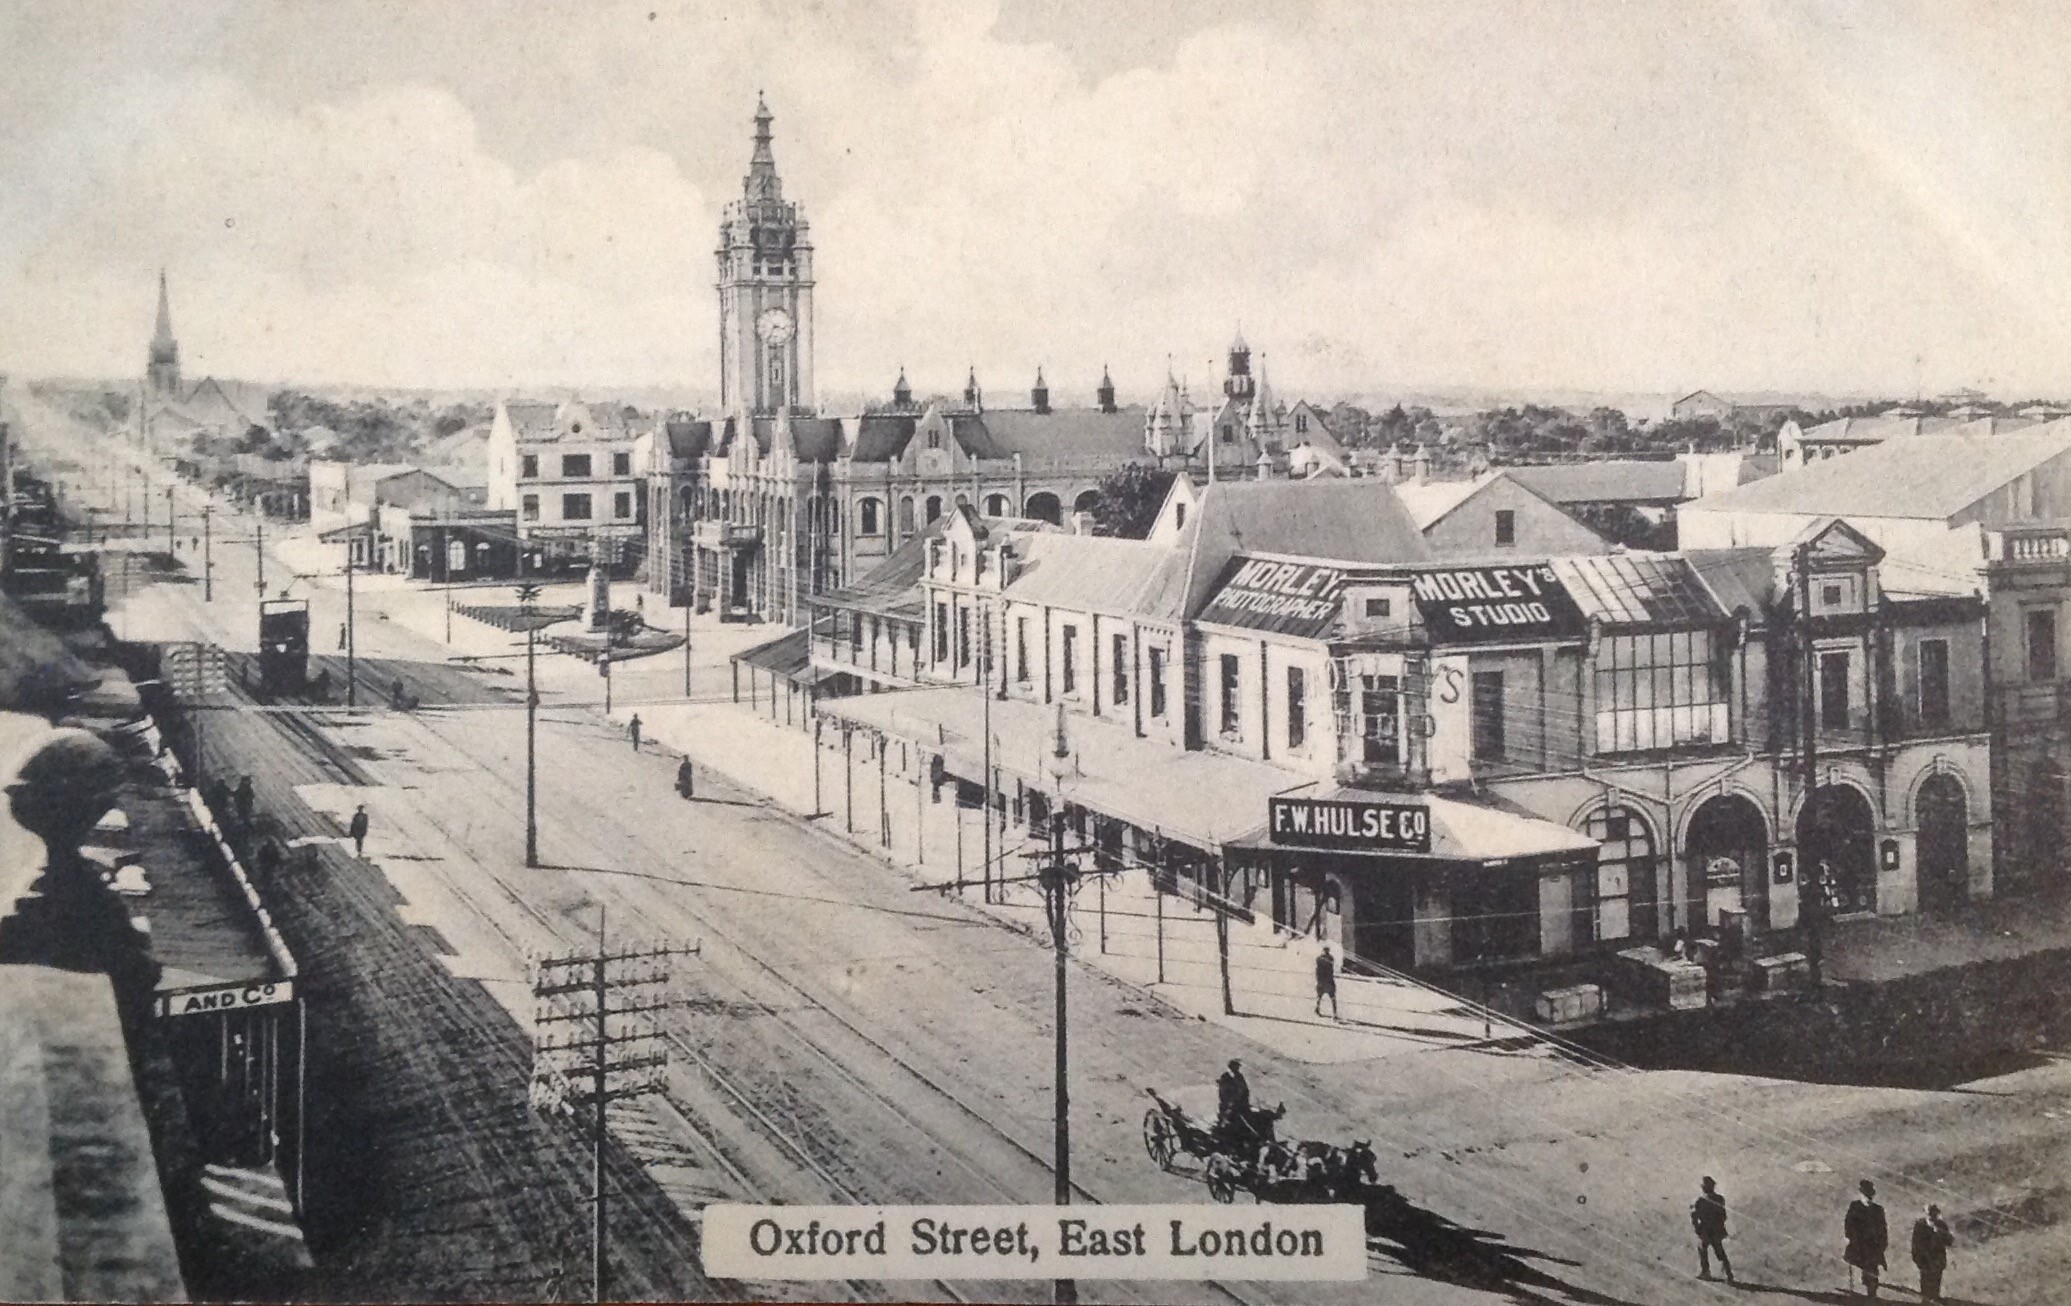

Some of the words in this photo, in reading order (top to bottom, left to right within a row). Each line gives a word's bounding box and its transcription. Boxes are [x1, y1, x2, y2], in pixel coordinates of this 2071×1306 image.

[1213, 587, 1335, 620] PHOTOGRAPHER
[1449, 602, 1551, 628] STUDIO
[184, 992, 236, 1012] AND
